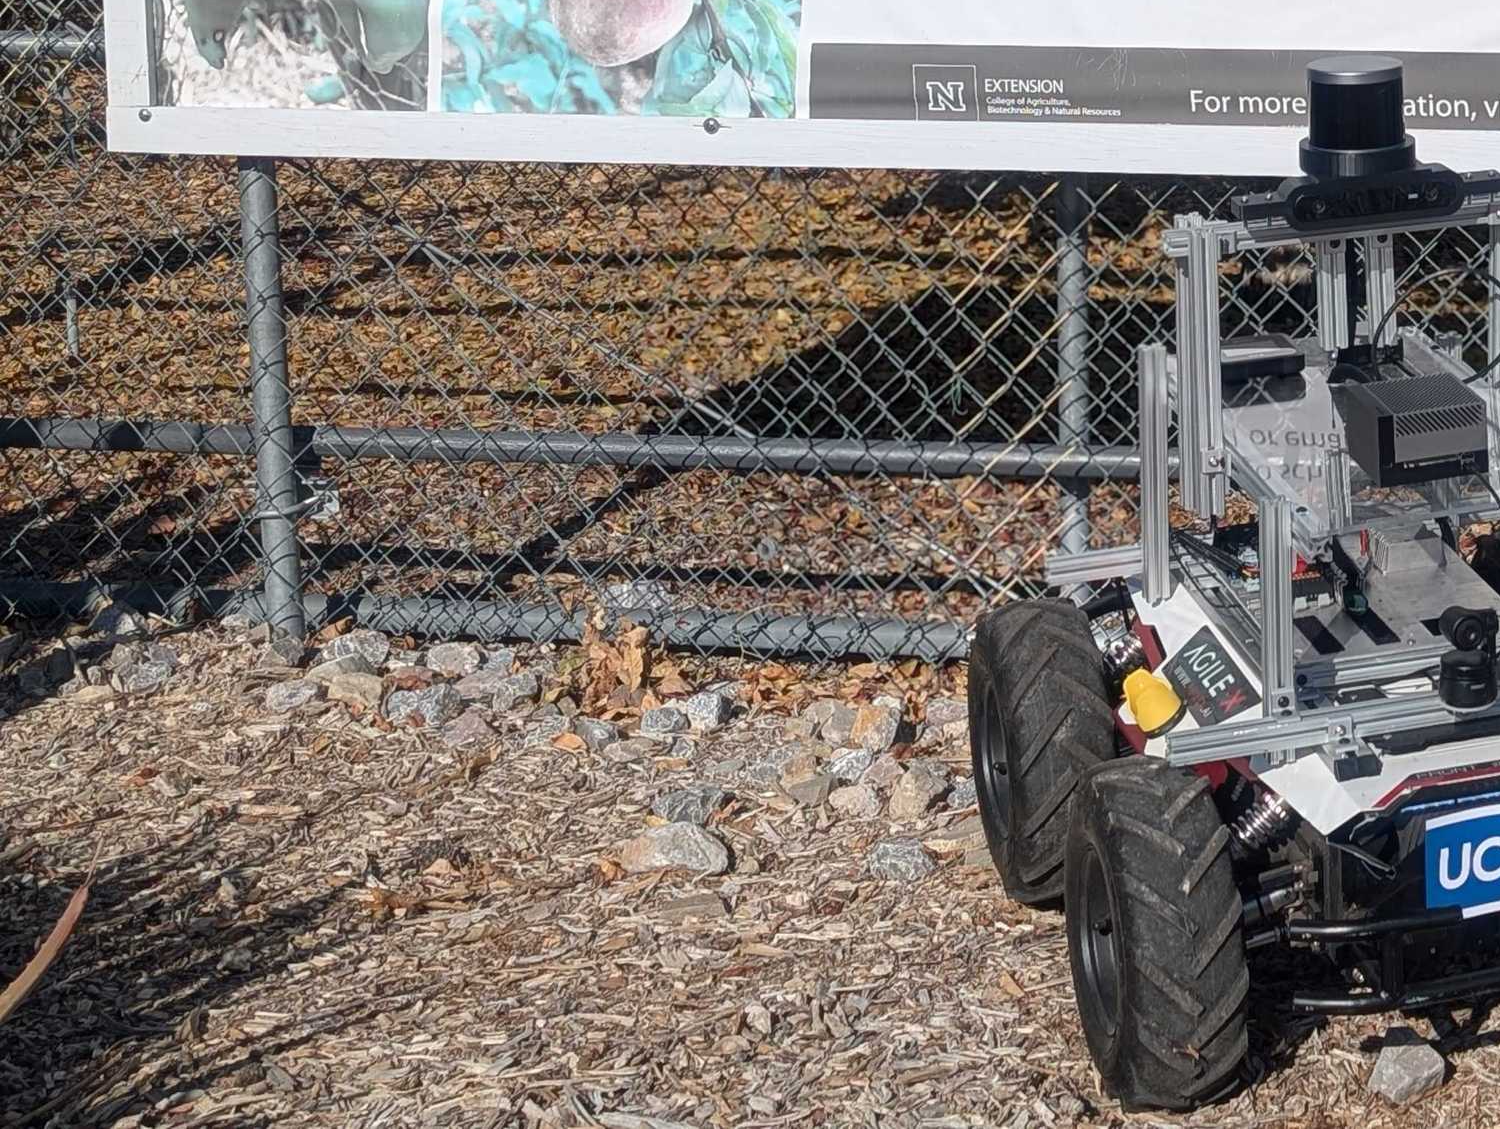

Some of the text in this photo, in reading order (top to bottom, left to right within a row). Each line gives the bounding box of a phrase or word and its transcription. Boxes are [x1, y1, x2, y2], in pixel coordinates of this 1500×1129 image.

[985, 78, 1064, 94] EXTENSION
[986, 97, 1071, 107] College of Agriculture,
[1190, 90, 1230, 112] For
[1239, 96, 1307, 114] more
[987, 106, 1043, 117] Biotechnology
[1052, 107, 1080, 116] Natural
[1082, 107, 1121, 117] Resources
